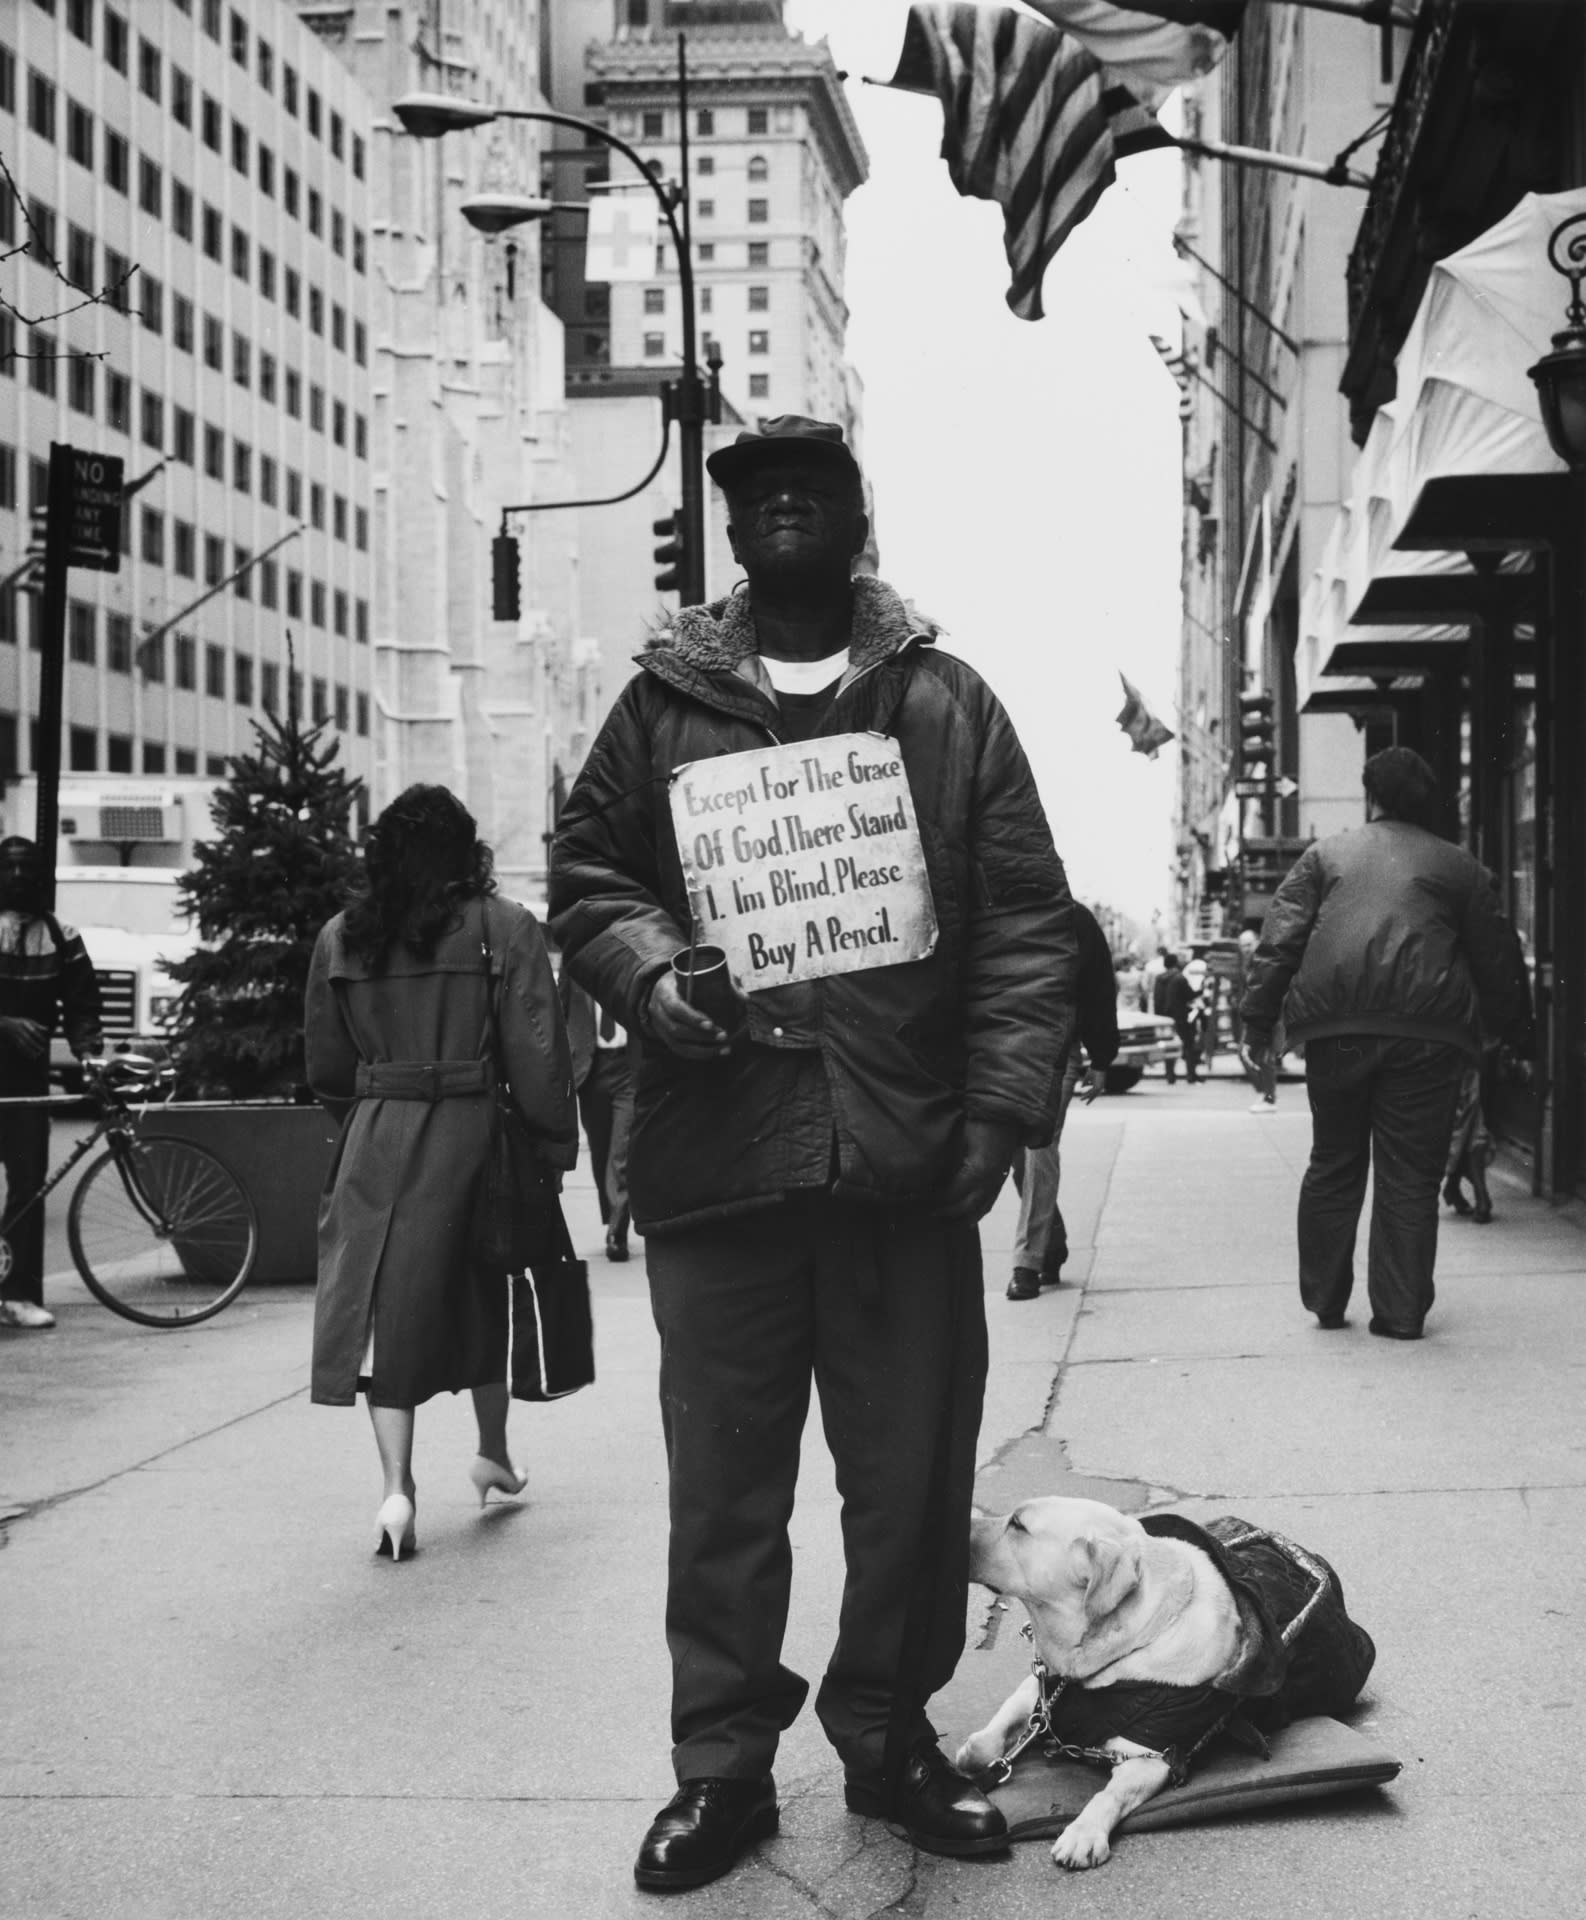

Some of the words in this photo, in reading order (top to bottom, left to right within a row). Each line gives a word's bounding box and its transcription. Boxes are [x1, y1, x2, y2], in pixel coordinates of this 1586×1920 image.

[74, 460, 105, 484] NO
[683, 781, 757, 816] Except
[760, 766, 799, 801] For
[801, 757, 843, 793] The
[847, 751, 900, 784] Grace
[693, 829, 725, 870] Of
[783, 815, 845, 853] There
[848, 795, 907, 840] Stand
[732, 877, 766, 915] I'm
[834, 856, 904, 893] Please
[748, 932, 796, 974] Buy
[805, 920, 824, 958] A
[826, 906, 899, 953] Pencil.
